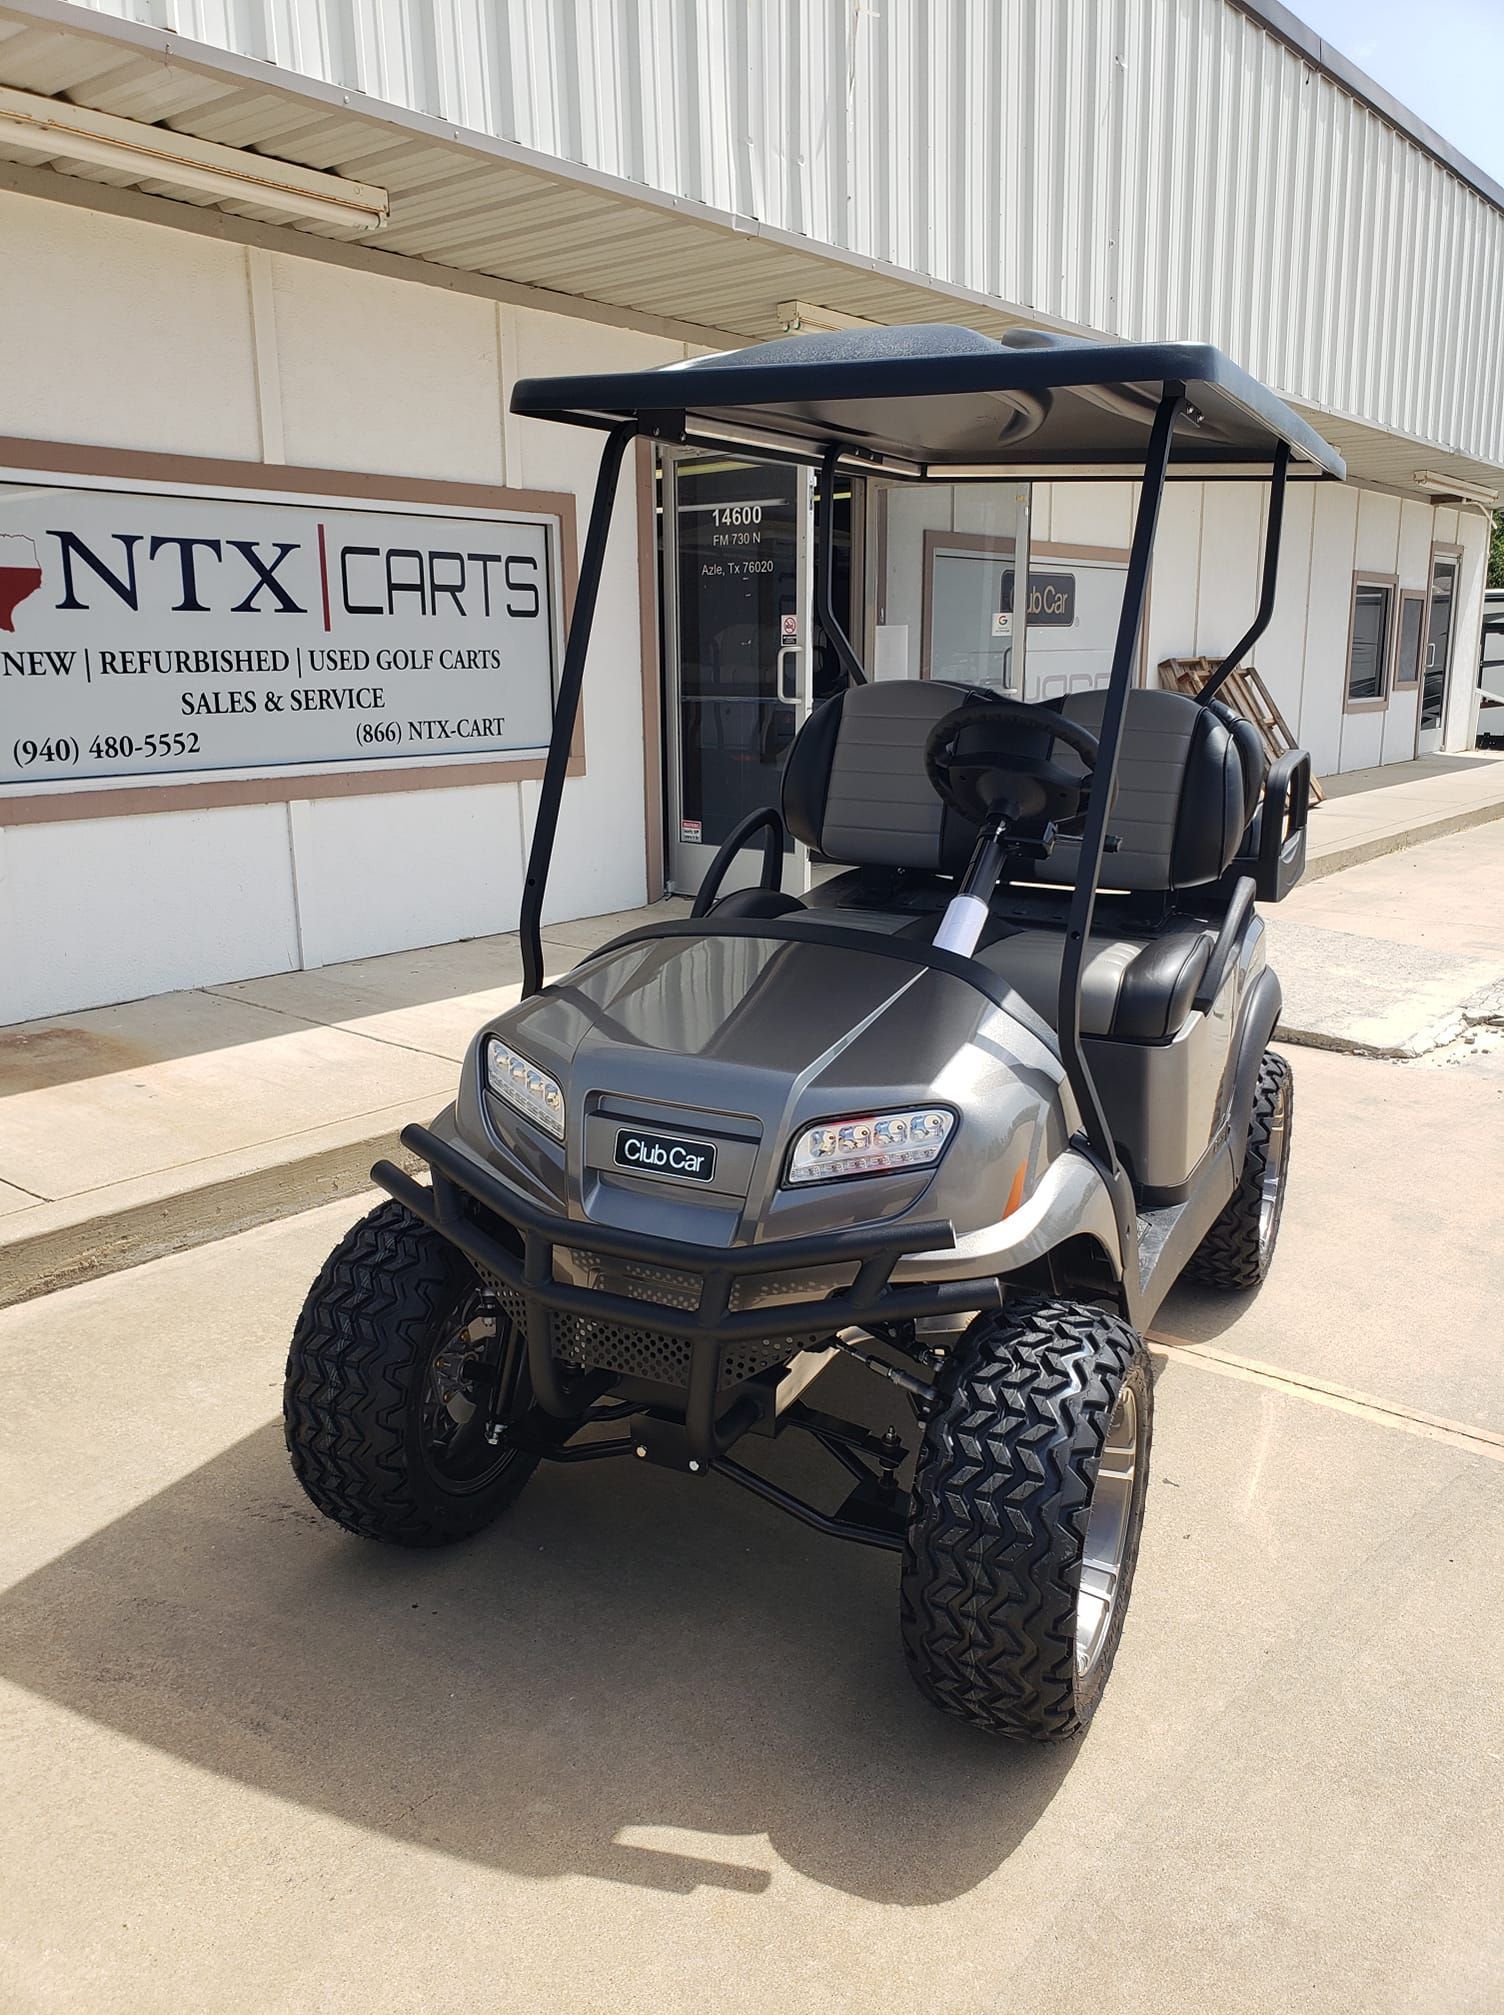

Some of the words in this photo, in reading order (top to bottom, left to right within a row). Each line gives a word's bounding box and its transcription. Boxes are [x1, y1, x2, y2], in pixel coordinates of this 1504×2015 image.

[712, 505, 762, 527] 14600
[713, 534, 729, 546] FM
[731, 532, 750, 545] 730
[752, 531, 761, 544] N
[45, 529, 308, 613] NTX
[340, 545, 539, 617] CARTS
[701, 564, 725, 576] Azle,
[728, 562, 740, 574] Tx
[742, 560, 774, 573] 76020
[1043, 585, 1068, 614] Car
[1, 650, 77, 676] NEW
[99, 650, 290, 674] REFURBISHED
[308, 650, 370, 671] USED
[376, 650, 434, 670] GOLF
[439, 649, 501, 670] CARTS
[181, 690, 257, 715] SALES
[264, 691, 285, 712] &
[290, 687, 386, 711] SERVICE
[356, 721, 402, 747] (866)
[408, 717, 505, 741] NTX-CART
[13, 736, 79, 768] (940)
[88, 732, 201, 759] 480-5552
[624, 1138, 668, 1166] Club
[669, 1146, 705, 1173] Car
